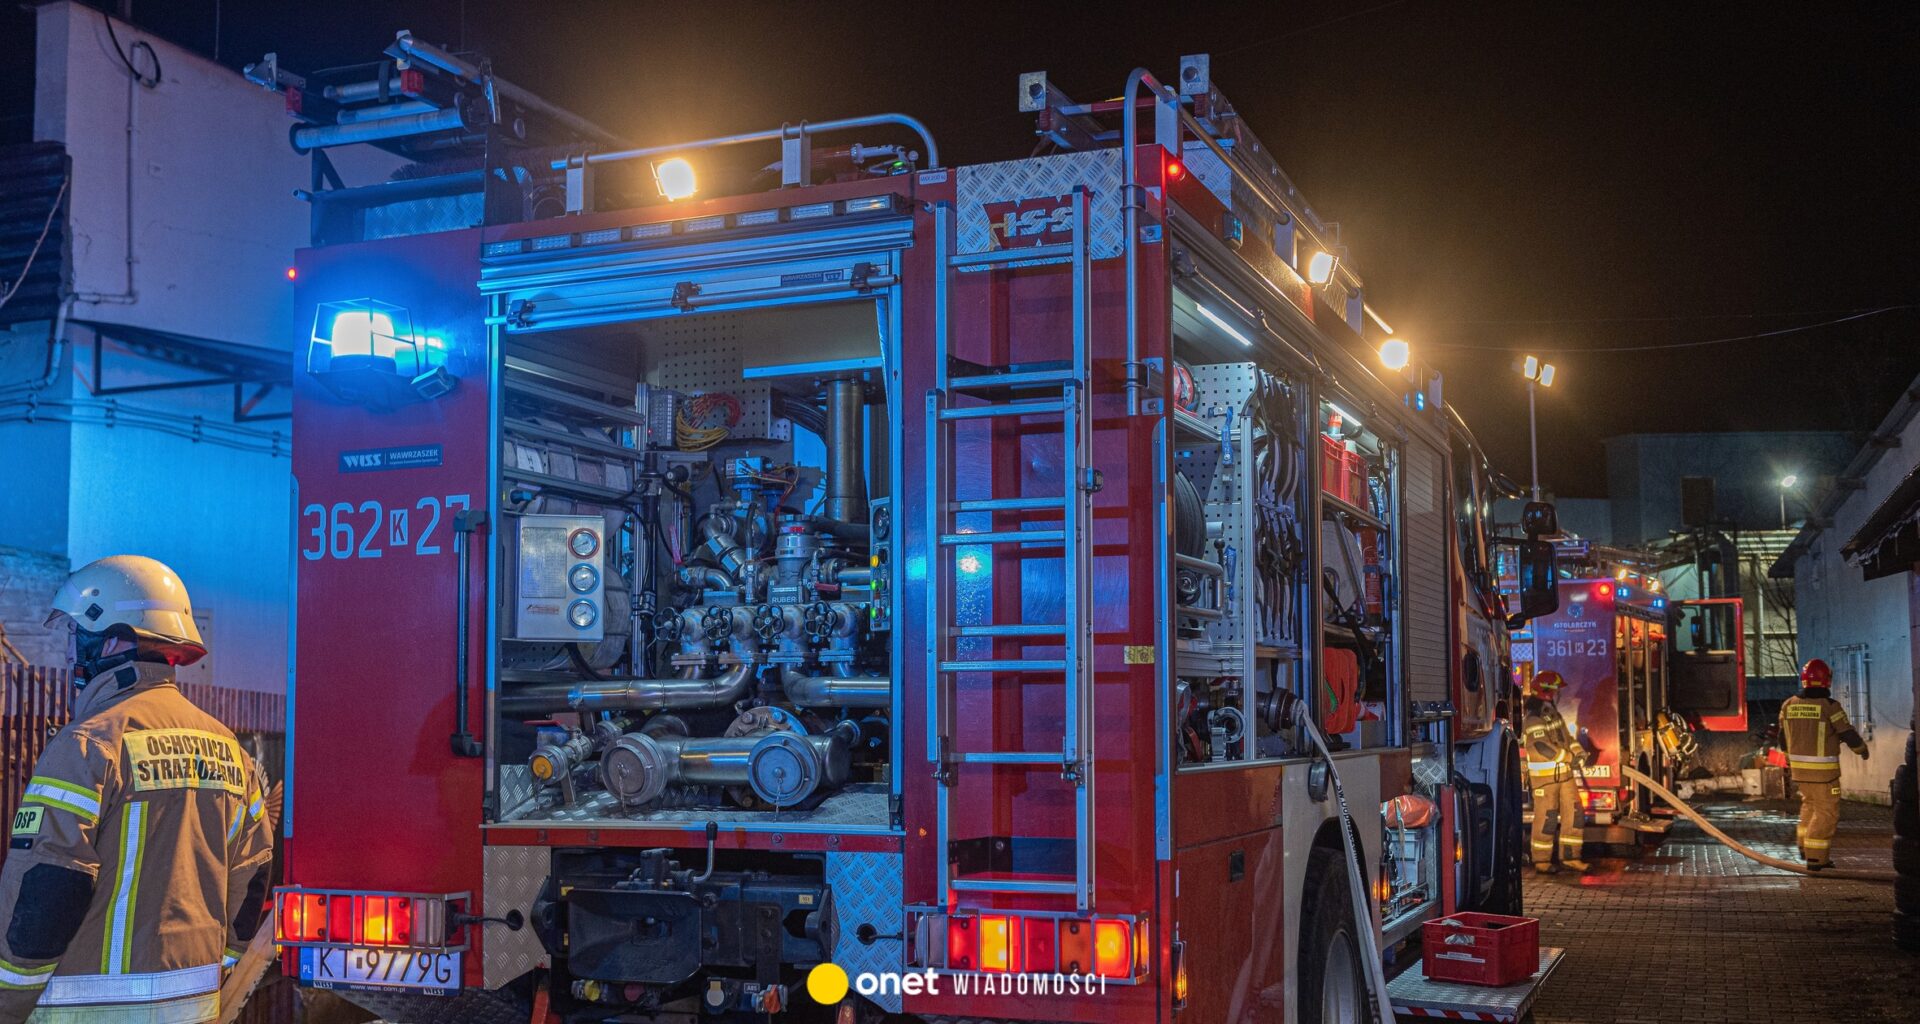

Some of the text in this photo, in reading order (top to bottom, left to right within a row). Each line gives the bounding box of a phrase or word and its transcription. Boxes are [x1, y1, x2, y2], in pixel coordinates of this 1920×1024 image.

[343, 453, 381, 468] WISS
[389, 449, 439, 460] WAWRZASZEK
[303, 500, 383, 561] 362
[1547, 640, 1572, 657] 361
[1586, 638, 1607, 656] 23
[146, 734, 235, 763] OCHOTNICZA
[15, 811, 37, 829] OSP
[303, 964, 312, 974] PL
[319, 947, 451, 984] KT 9779G
